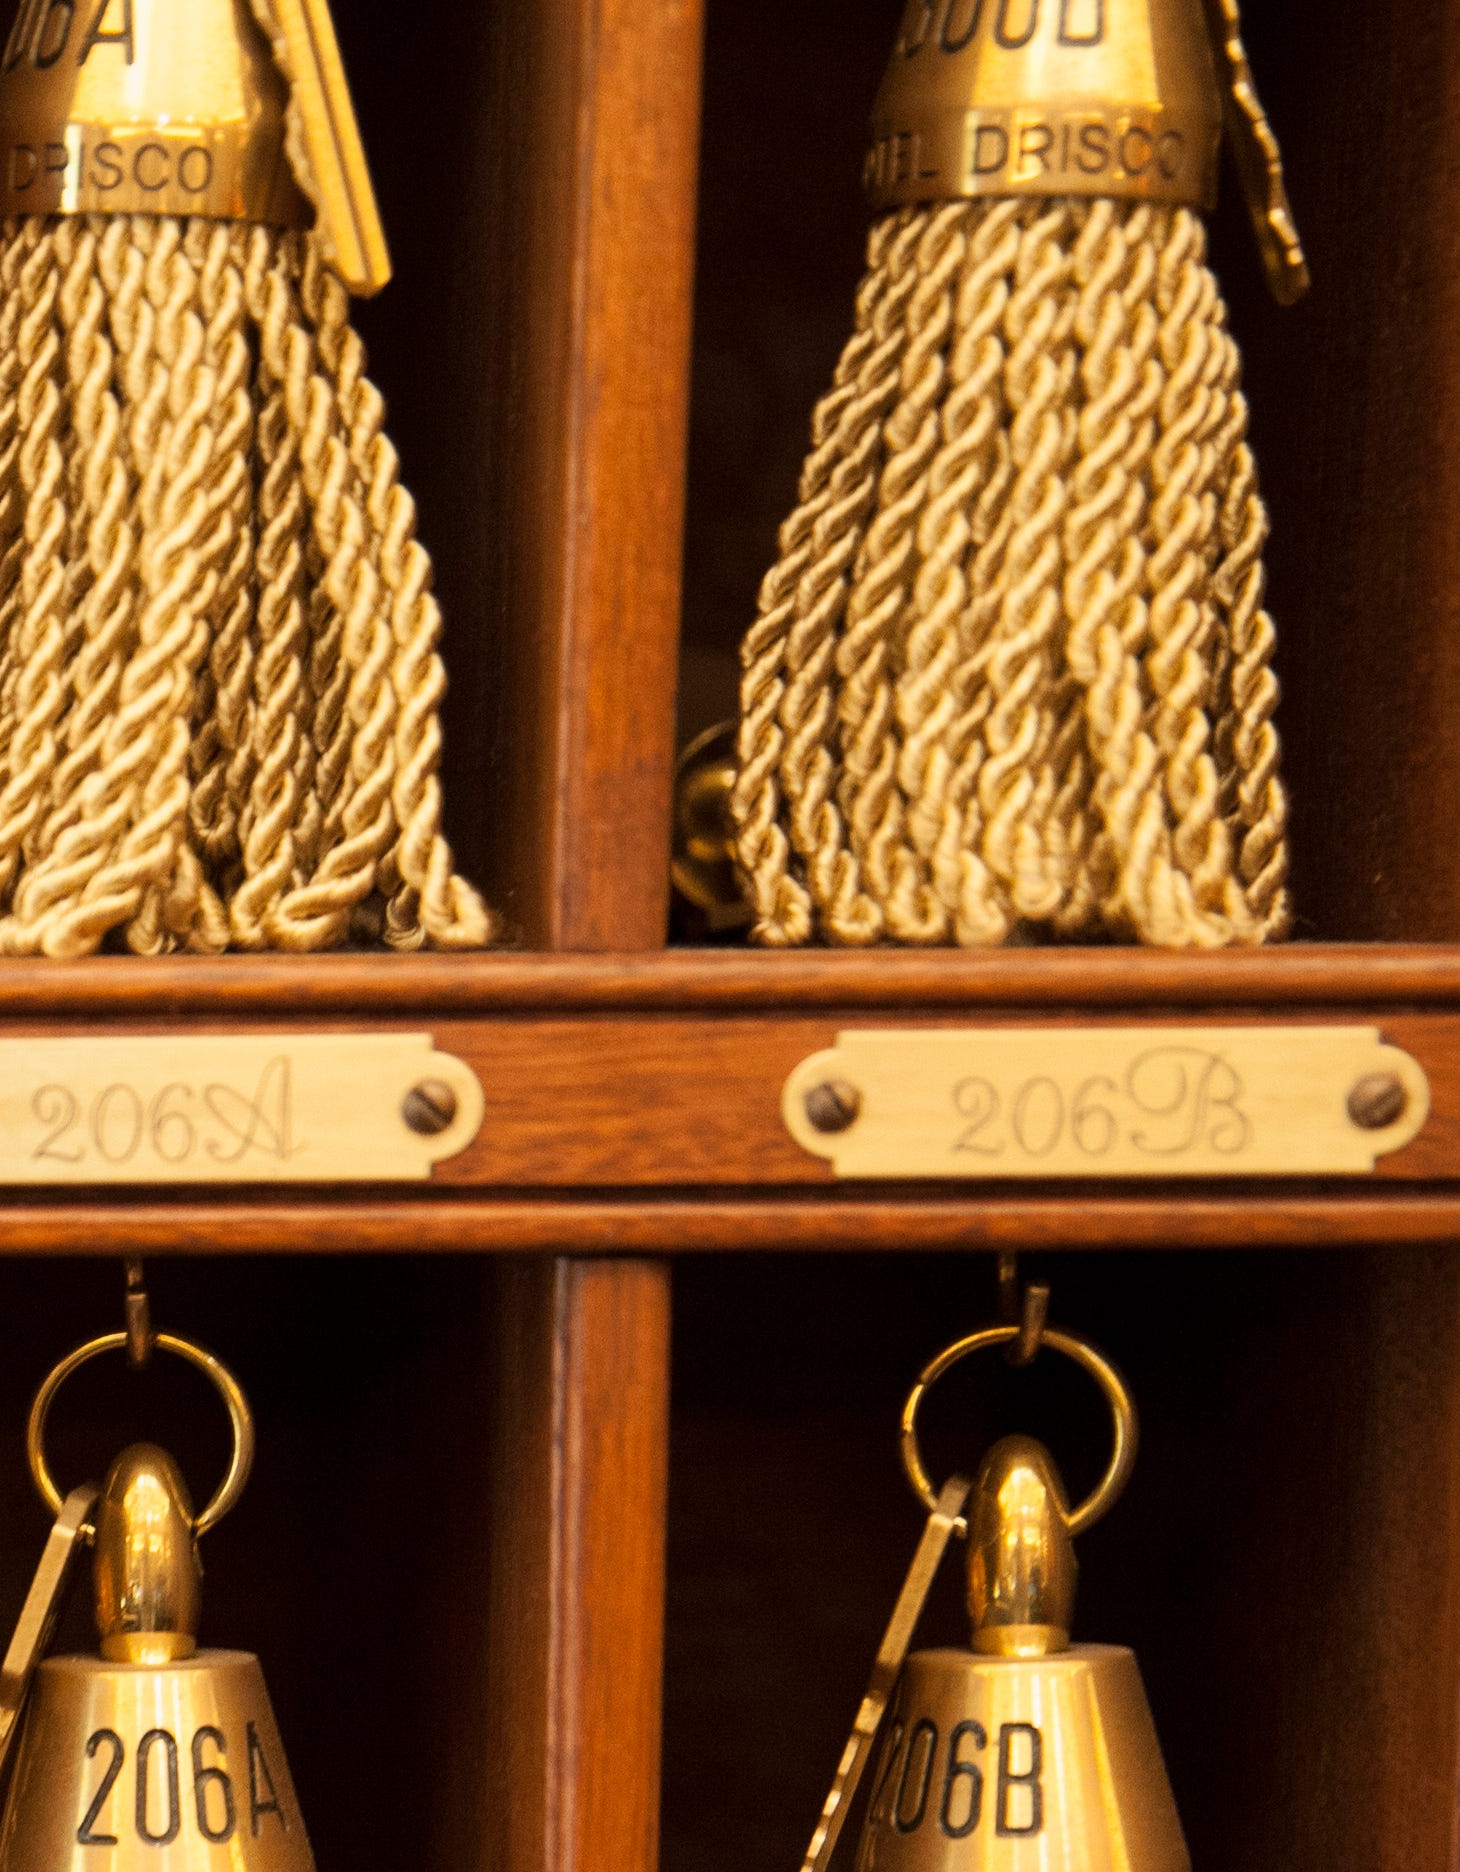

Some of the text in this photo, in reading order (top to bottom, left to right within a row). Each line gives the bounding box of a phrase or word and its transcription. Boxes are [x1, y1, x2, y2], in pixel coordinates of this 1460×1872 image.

[973, 123, 1182, 181] DRISCO
[29, 1052, 308, 1165] 206A
[951, 1044, 1255, 1159] 206B
[76, 1720, 292, 1847] 206A
